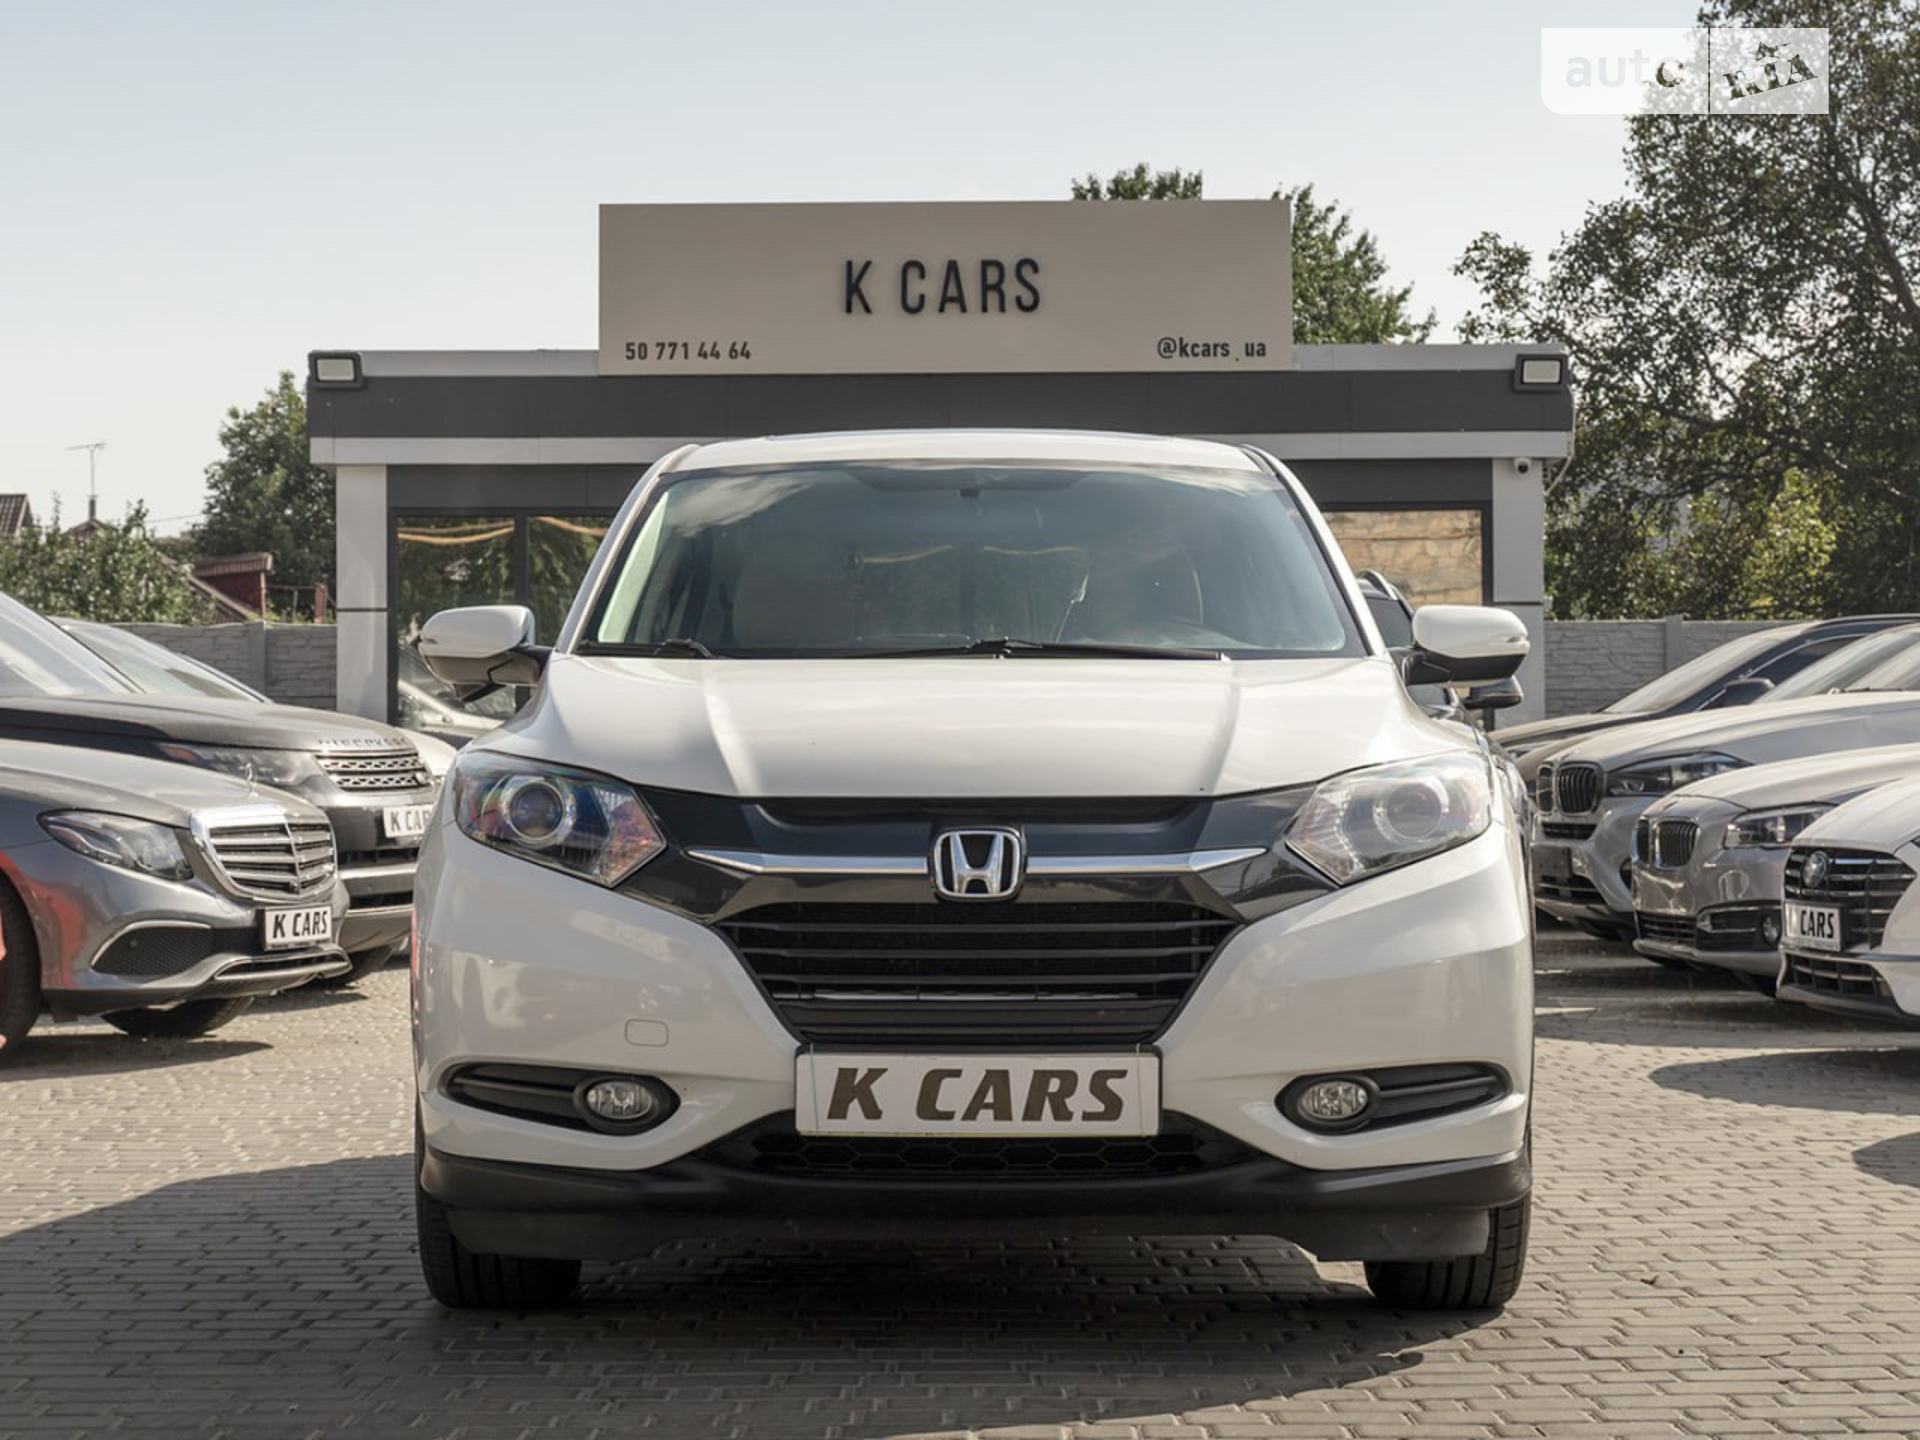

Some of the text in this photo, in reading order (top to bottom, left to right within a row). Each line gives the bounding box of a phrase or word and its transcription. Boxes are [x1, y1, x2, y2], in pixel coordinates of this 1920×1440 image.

[845, 257, 1041, 315] K CARS
[625, 341, 752, 361] 50 771 44 64
[390, 811, 402, 832] K
[273, 910, 328, 939] K CARS
[1800, 909, 1835, 939] CARS
[827, 1067, 1129, 1122] K CARS
